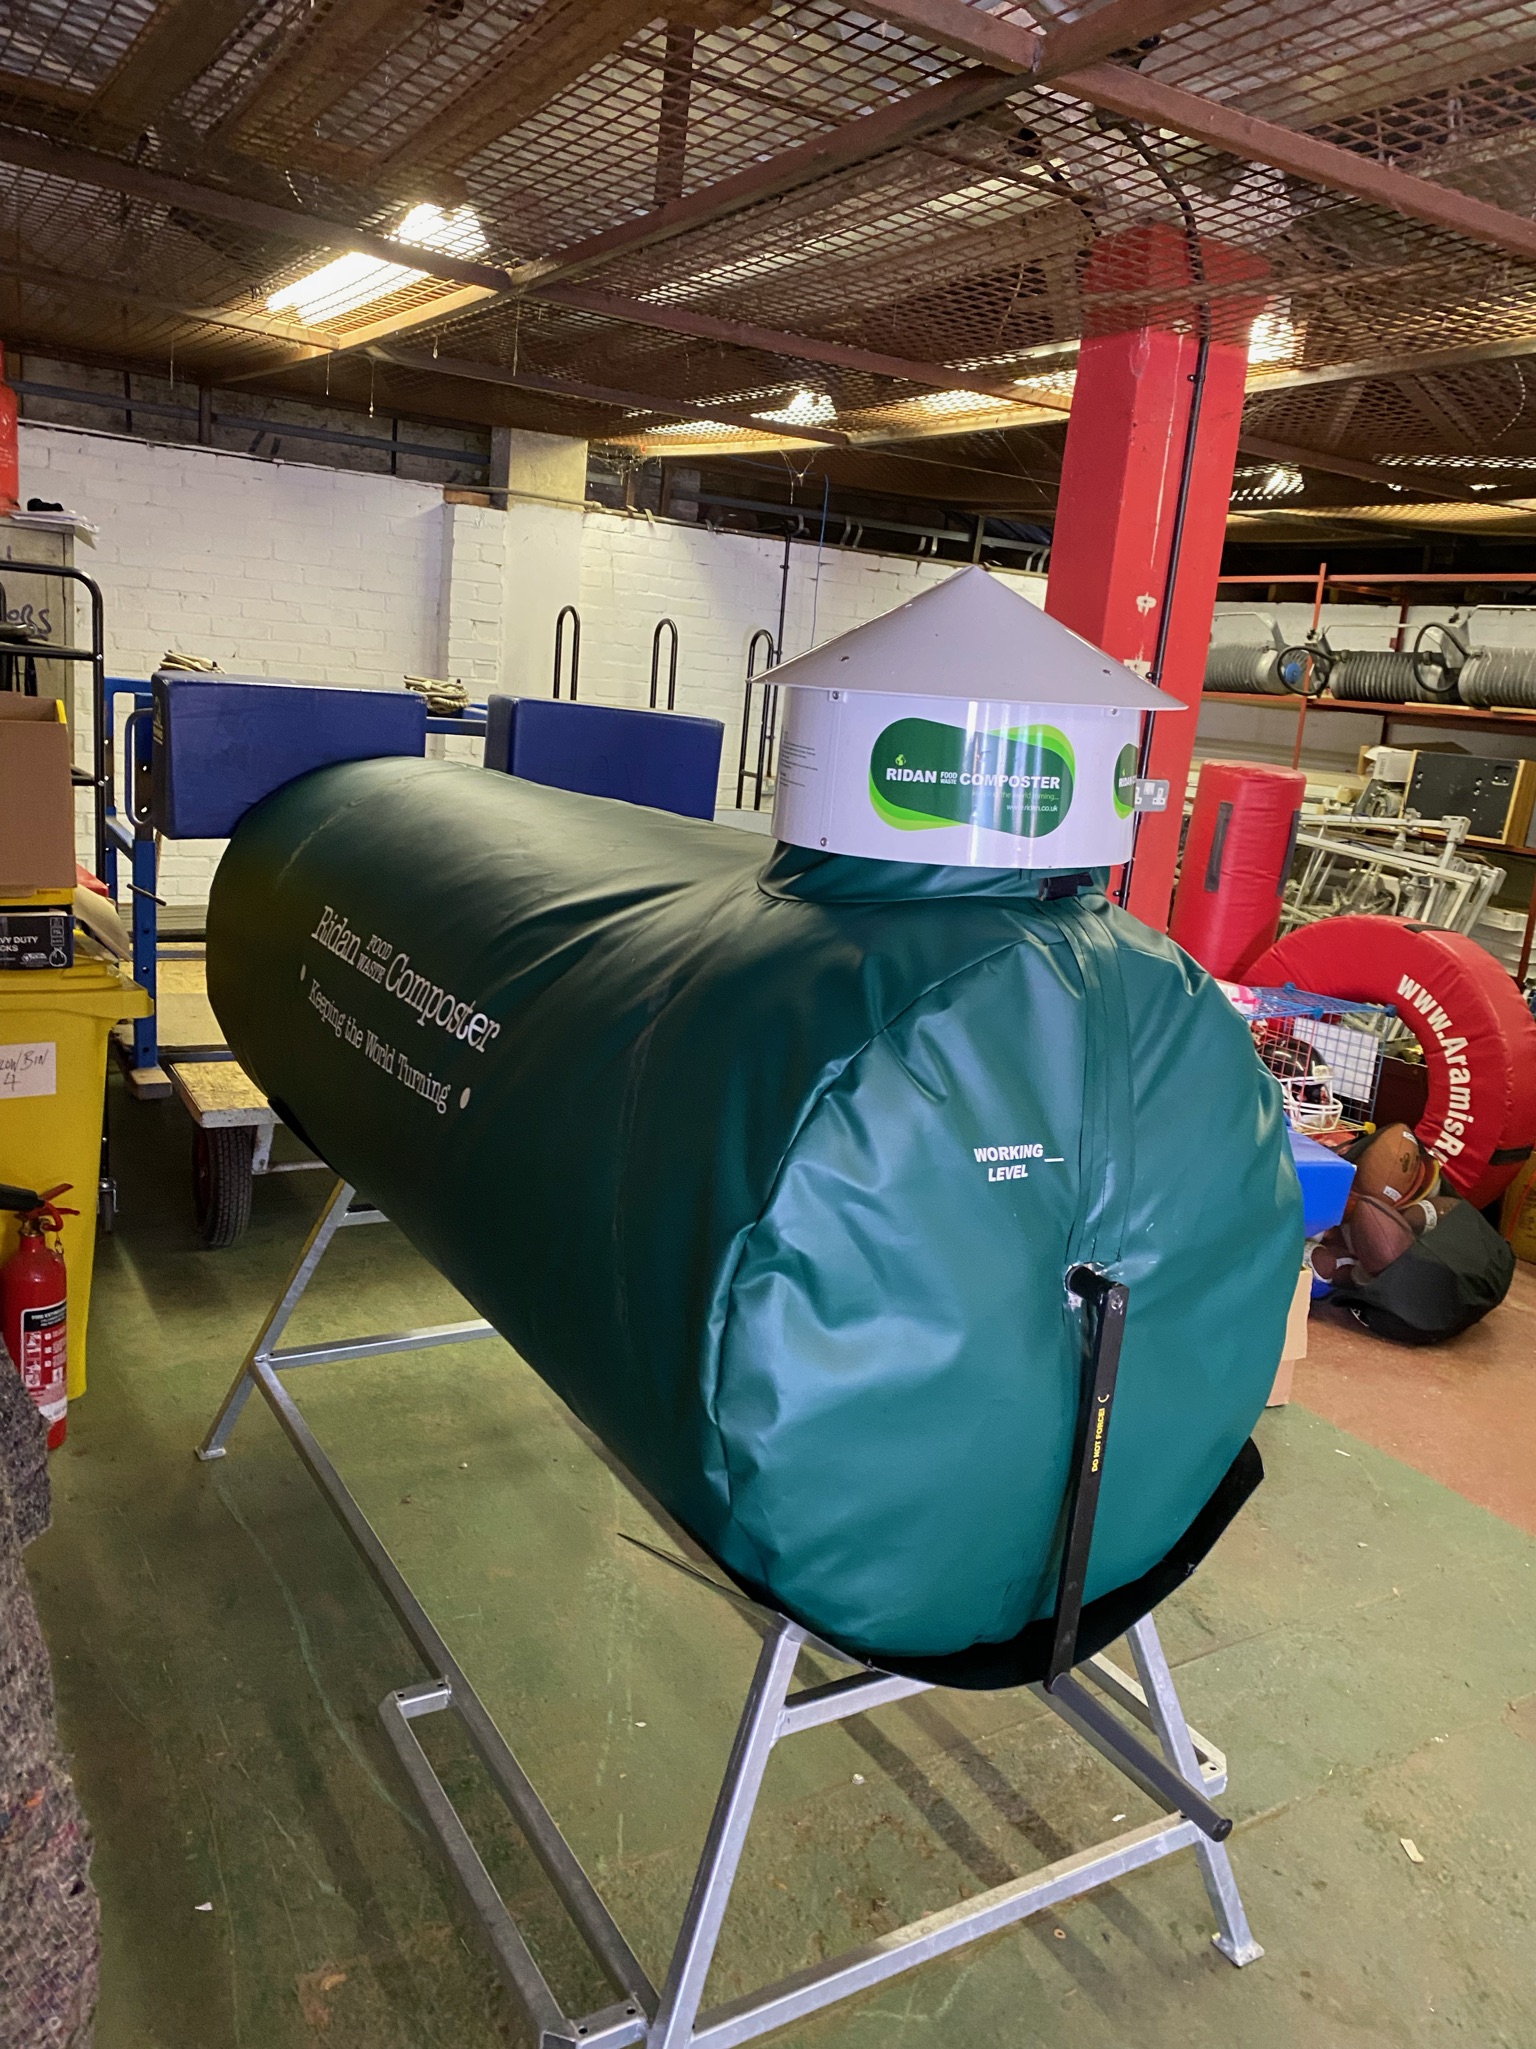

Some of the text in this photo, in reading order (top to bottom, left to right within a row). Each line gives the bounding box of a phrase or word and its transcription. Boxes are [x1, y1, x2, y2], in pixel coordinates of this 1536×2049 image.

[886, 768, 937, 783] RIDAN
[940, 771, 958, 779] FOOD
[959, 773, 1061, 789] COMPOSTER
[13, 936, 38, 944] DUTY
[311, 905, 500, 1053] Ridan FOOD WASTE Composter
[308, 978, 451, 1114] Keeping the World Turning
[3, 1072, 22, 1092] 4
[973, 1143, 1044, 1162] WORKING
[988, 1164, 1029, 1182] LEVEL
[1092, 1459, 1099, 1472] DO
